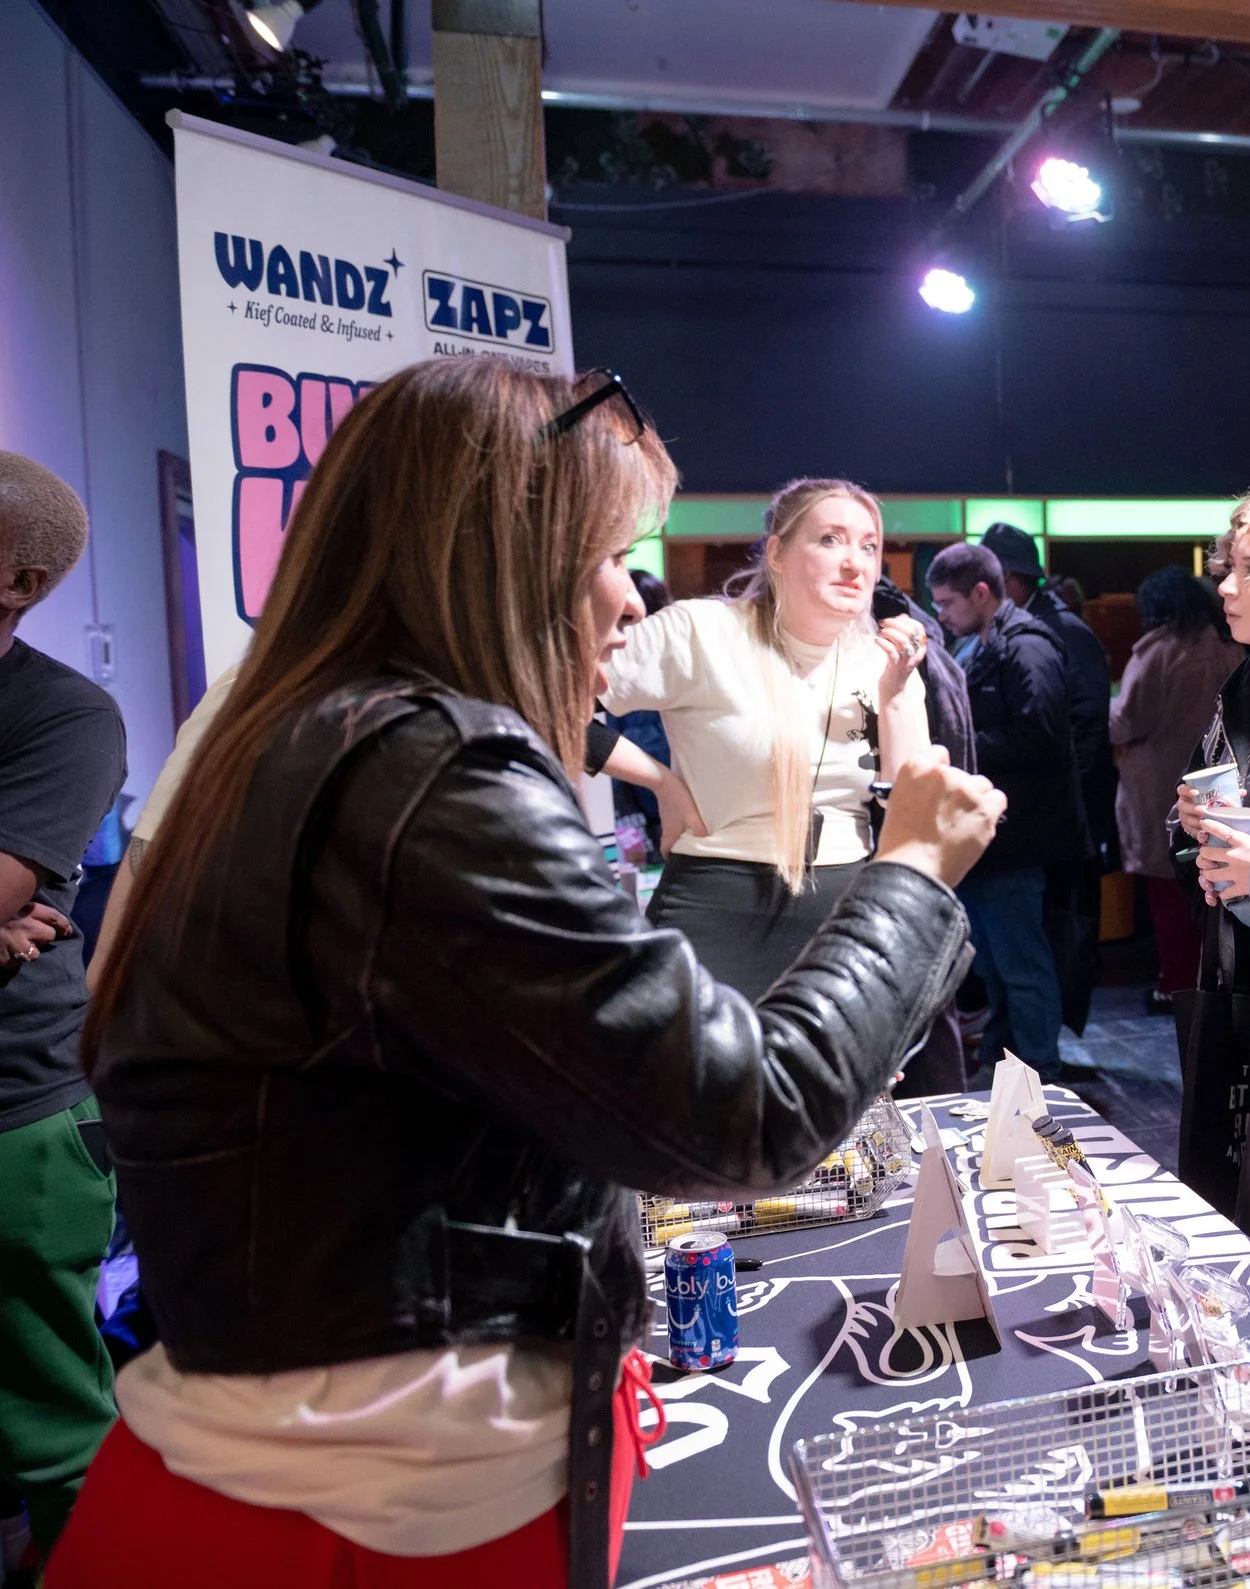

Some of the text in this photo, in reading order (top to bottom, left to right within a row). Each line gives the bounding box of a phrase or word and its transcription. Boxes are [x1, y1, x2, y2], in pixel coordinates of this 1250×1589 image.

[214, 231, 392, 317] WANDZ
[245, 301, 382, 342] Kief Coated & Infused
[427, 276, 550, 347] ZAPZ
[665, 1276, 710, 1300] ubly
